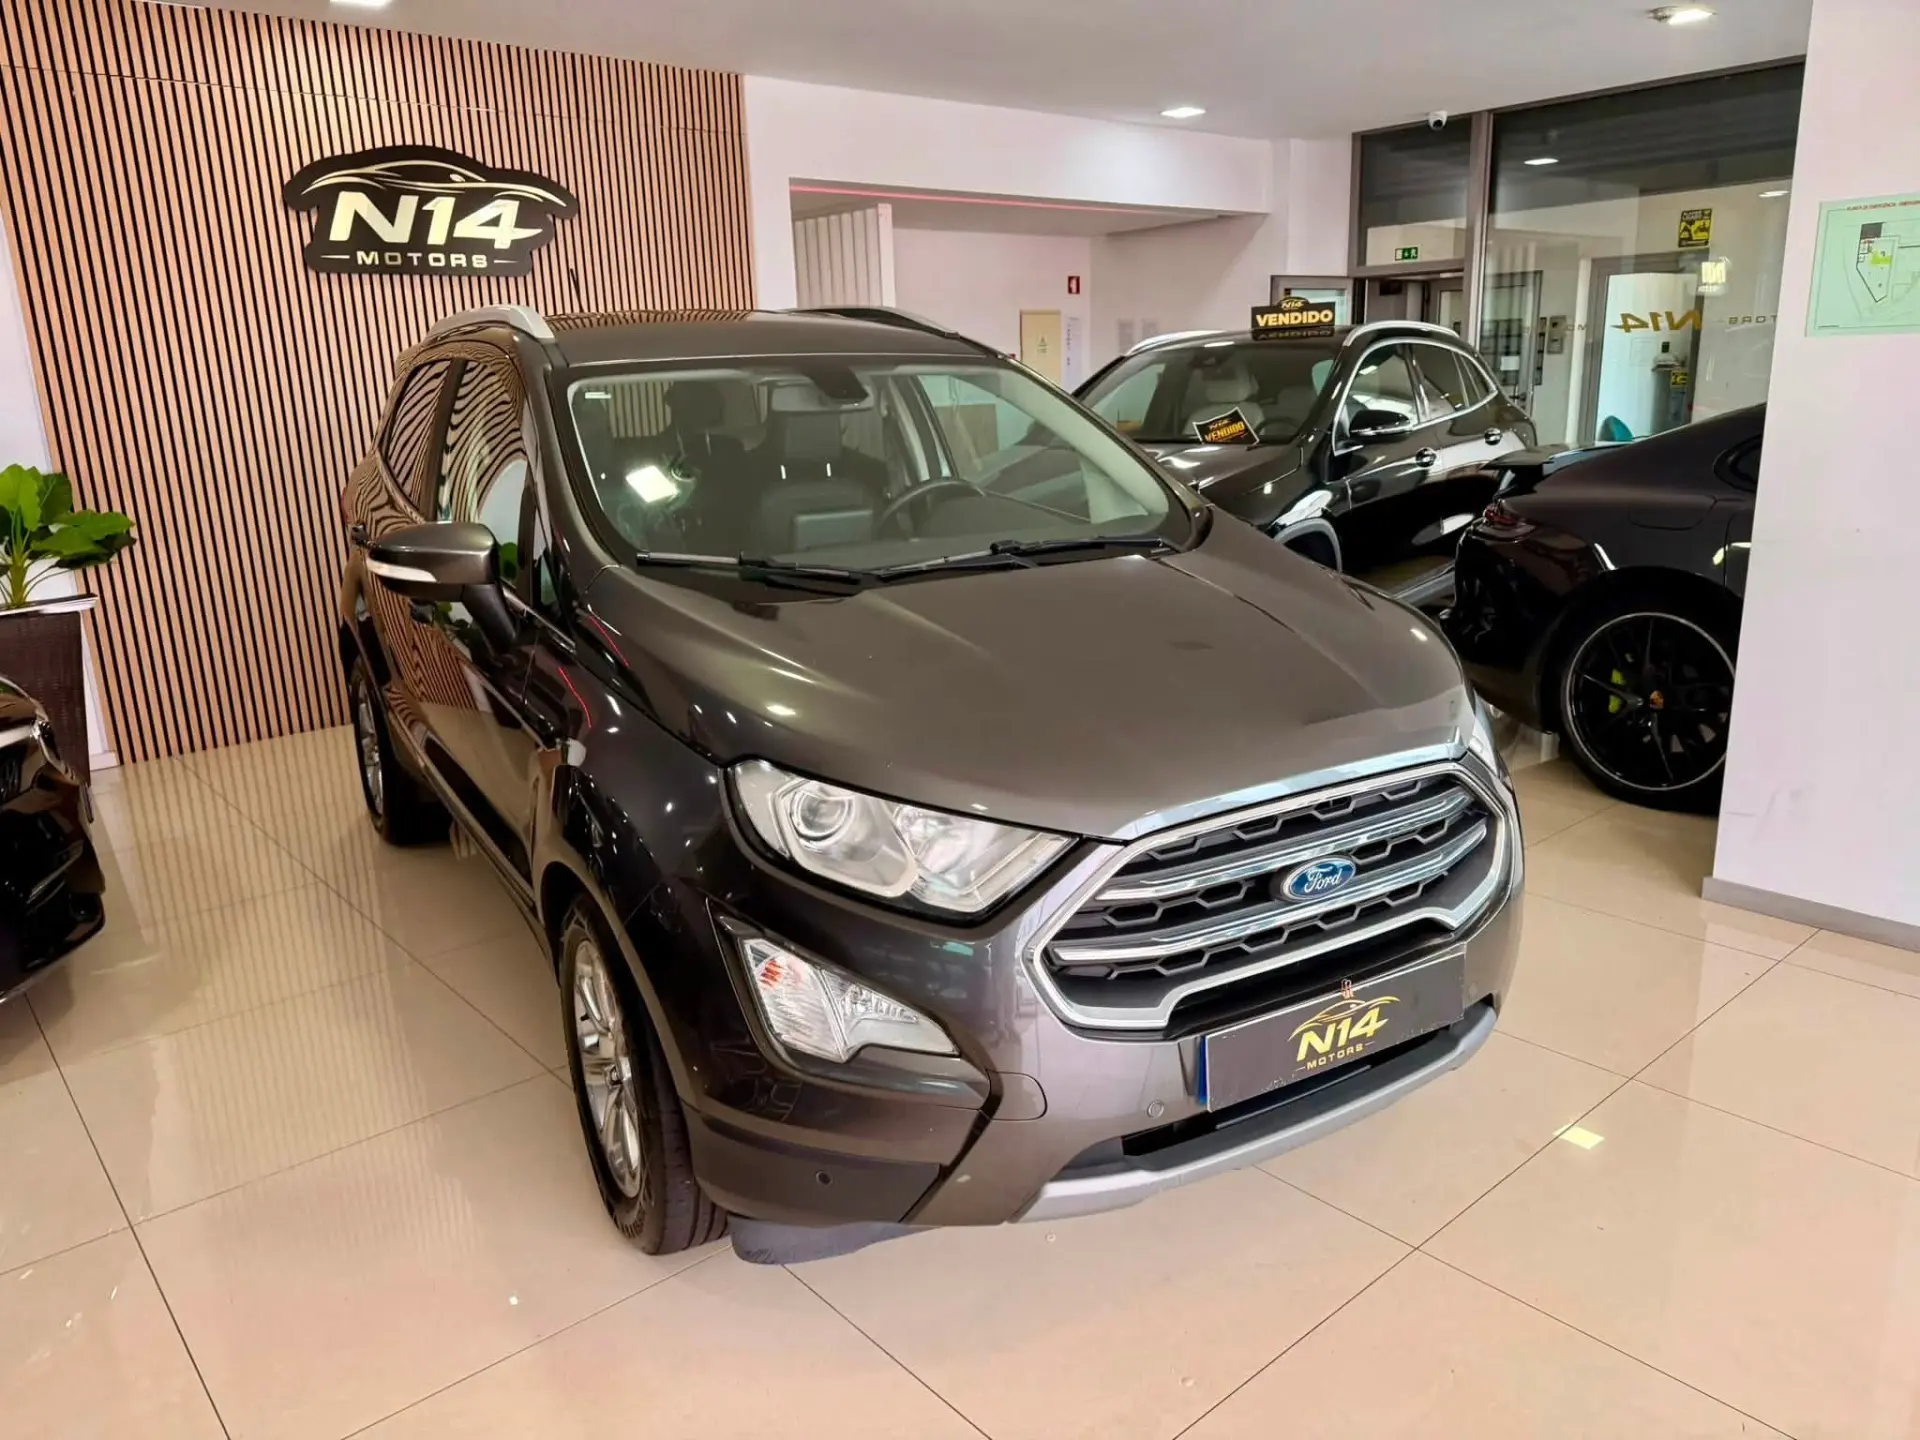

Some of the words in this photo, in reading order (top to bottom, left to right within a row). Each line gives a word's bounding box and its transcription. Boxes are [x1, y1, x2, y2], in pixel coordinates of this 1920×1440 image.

[329, 191, 543, 249] N14
[357, 251, 488, 268] MOTORS
[1256, 310, 1333, 326] VENDIDO
[1204, 421, 1245, 442] VENDIDO
[1304, 863, 1343, 893] Ford
[1297, 1007, 1389, 1061] N14
[1307, 1043, 1364, 1070] MOTORS
